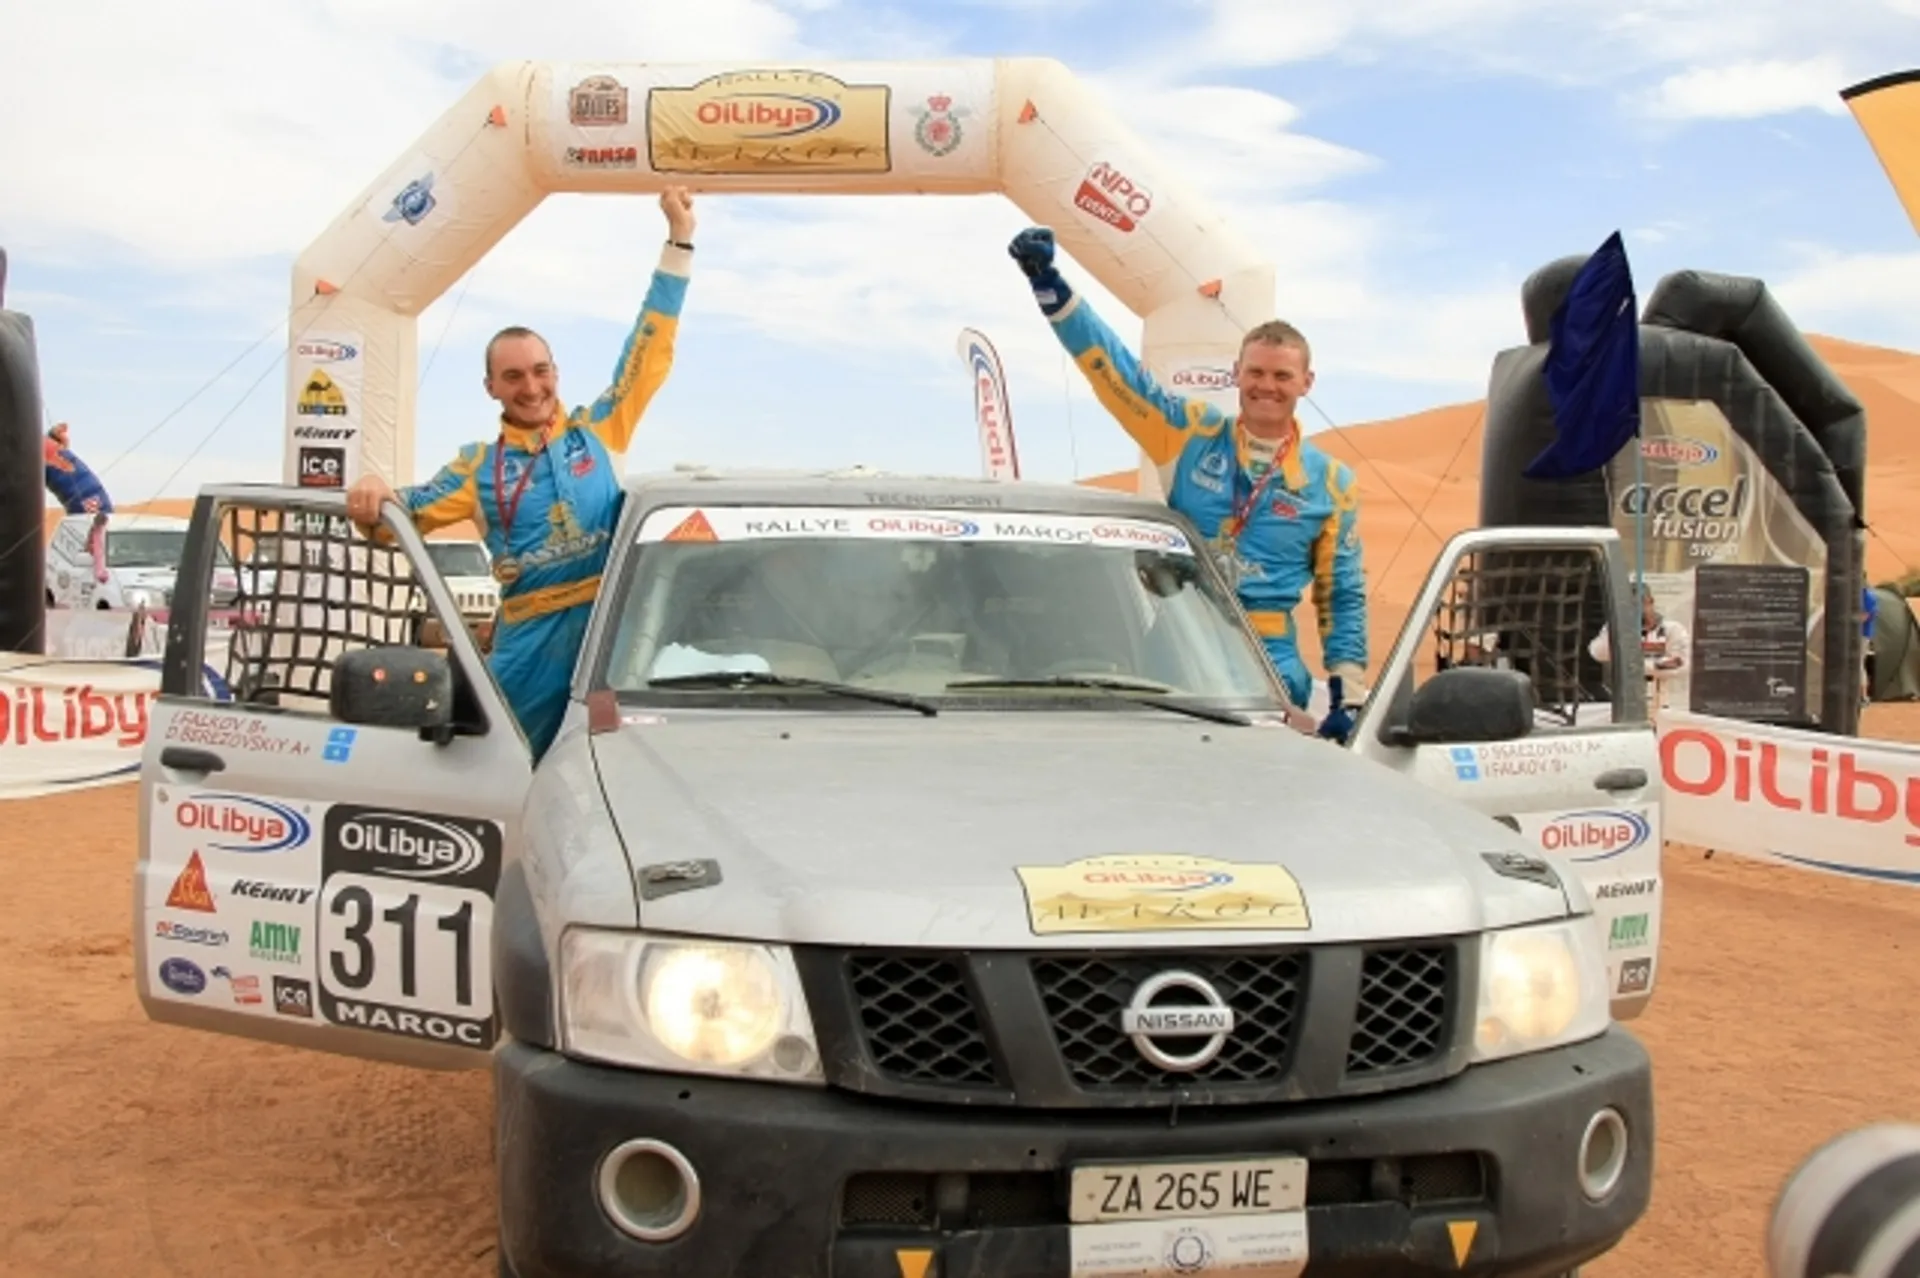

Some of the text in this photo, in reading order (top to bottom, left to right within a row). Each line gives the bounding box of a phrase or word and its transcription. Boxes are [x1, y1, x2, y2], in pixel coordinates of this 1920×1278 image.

[698, 102, 815, 127] OiLibya
[1091, 160, 1151, 217] NPO
[1621, 474, 1746, 518] accel
[746, 518, 851, 533] RALLYE
[868, 518, 959, 534] OiLibya
[1652, 512, 1739, 540] fusion
[0, 685, 162, 747] iLiby
[176, 801, 284, 841] OiLibya
[1541, 822, 1631, 849] OiLibya
[339, 822, 458, 864] OiLibya
[231, 879, 315, 904] KENNY
[330, 886, 474, 1007] 311
[336, 1001, 482, 1045] MAROC
[1136, 1012, 1226, 1030] NISSAN
[1100, 1168, 1275, 1214] ZA 265 WE
